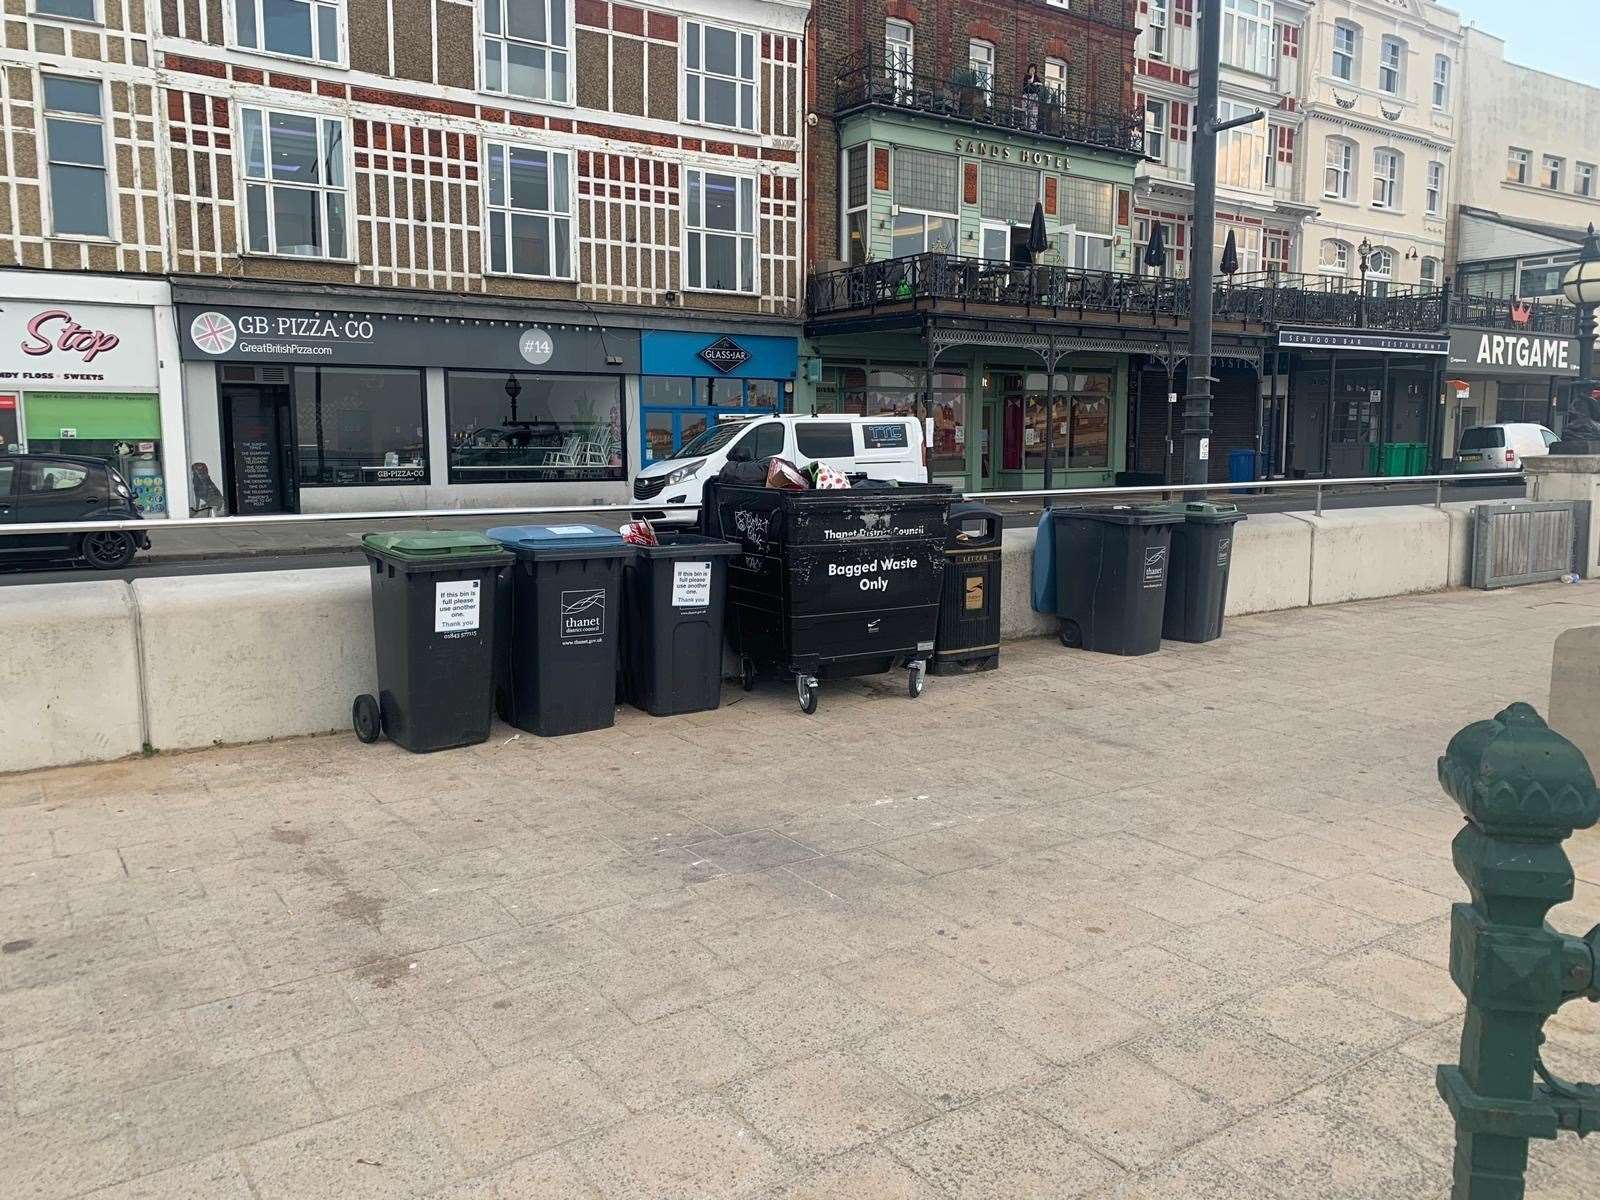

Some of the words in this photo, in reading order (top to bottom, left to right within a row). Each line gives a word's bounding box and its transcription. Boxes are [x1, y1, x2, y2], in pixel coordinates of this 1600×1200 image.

[954, 138, 1010, 158] SANDS
[1020, 150, 1072, 170] HOTEL
[238, 316, 268, 334] GB
[276, 317, 340, 338] PIZZA
[344, 320, 374, 339] CO
[21, 310, 120, 362] Stop
[1288, 335, 1336, 344] SEAFOOD
[1381, 340, 1442, 350] RESTAURANT
[524, 340, 550, 354] #14
[1476, 334, 1569, 369] ARTGAME
[64, 373, 104, 381] SWEETS
[824, 530, 856, 539] Thanet
[828, 559, 878, 577] Bagged
[880, 558, 918, 571] Waste
[860, 576, 888, 592] Only
[566, 617, 600, 627] thanet
